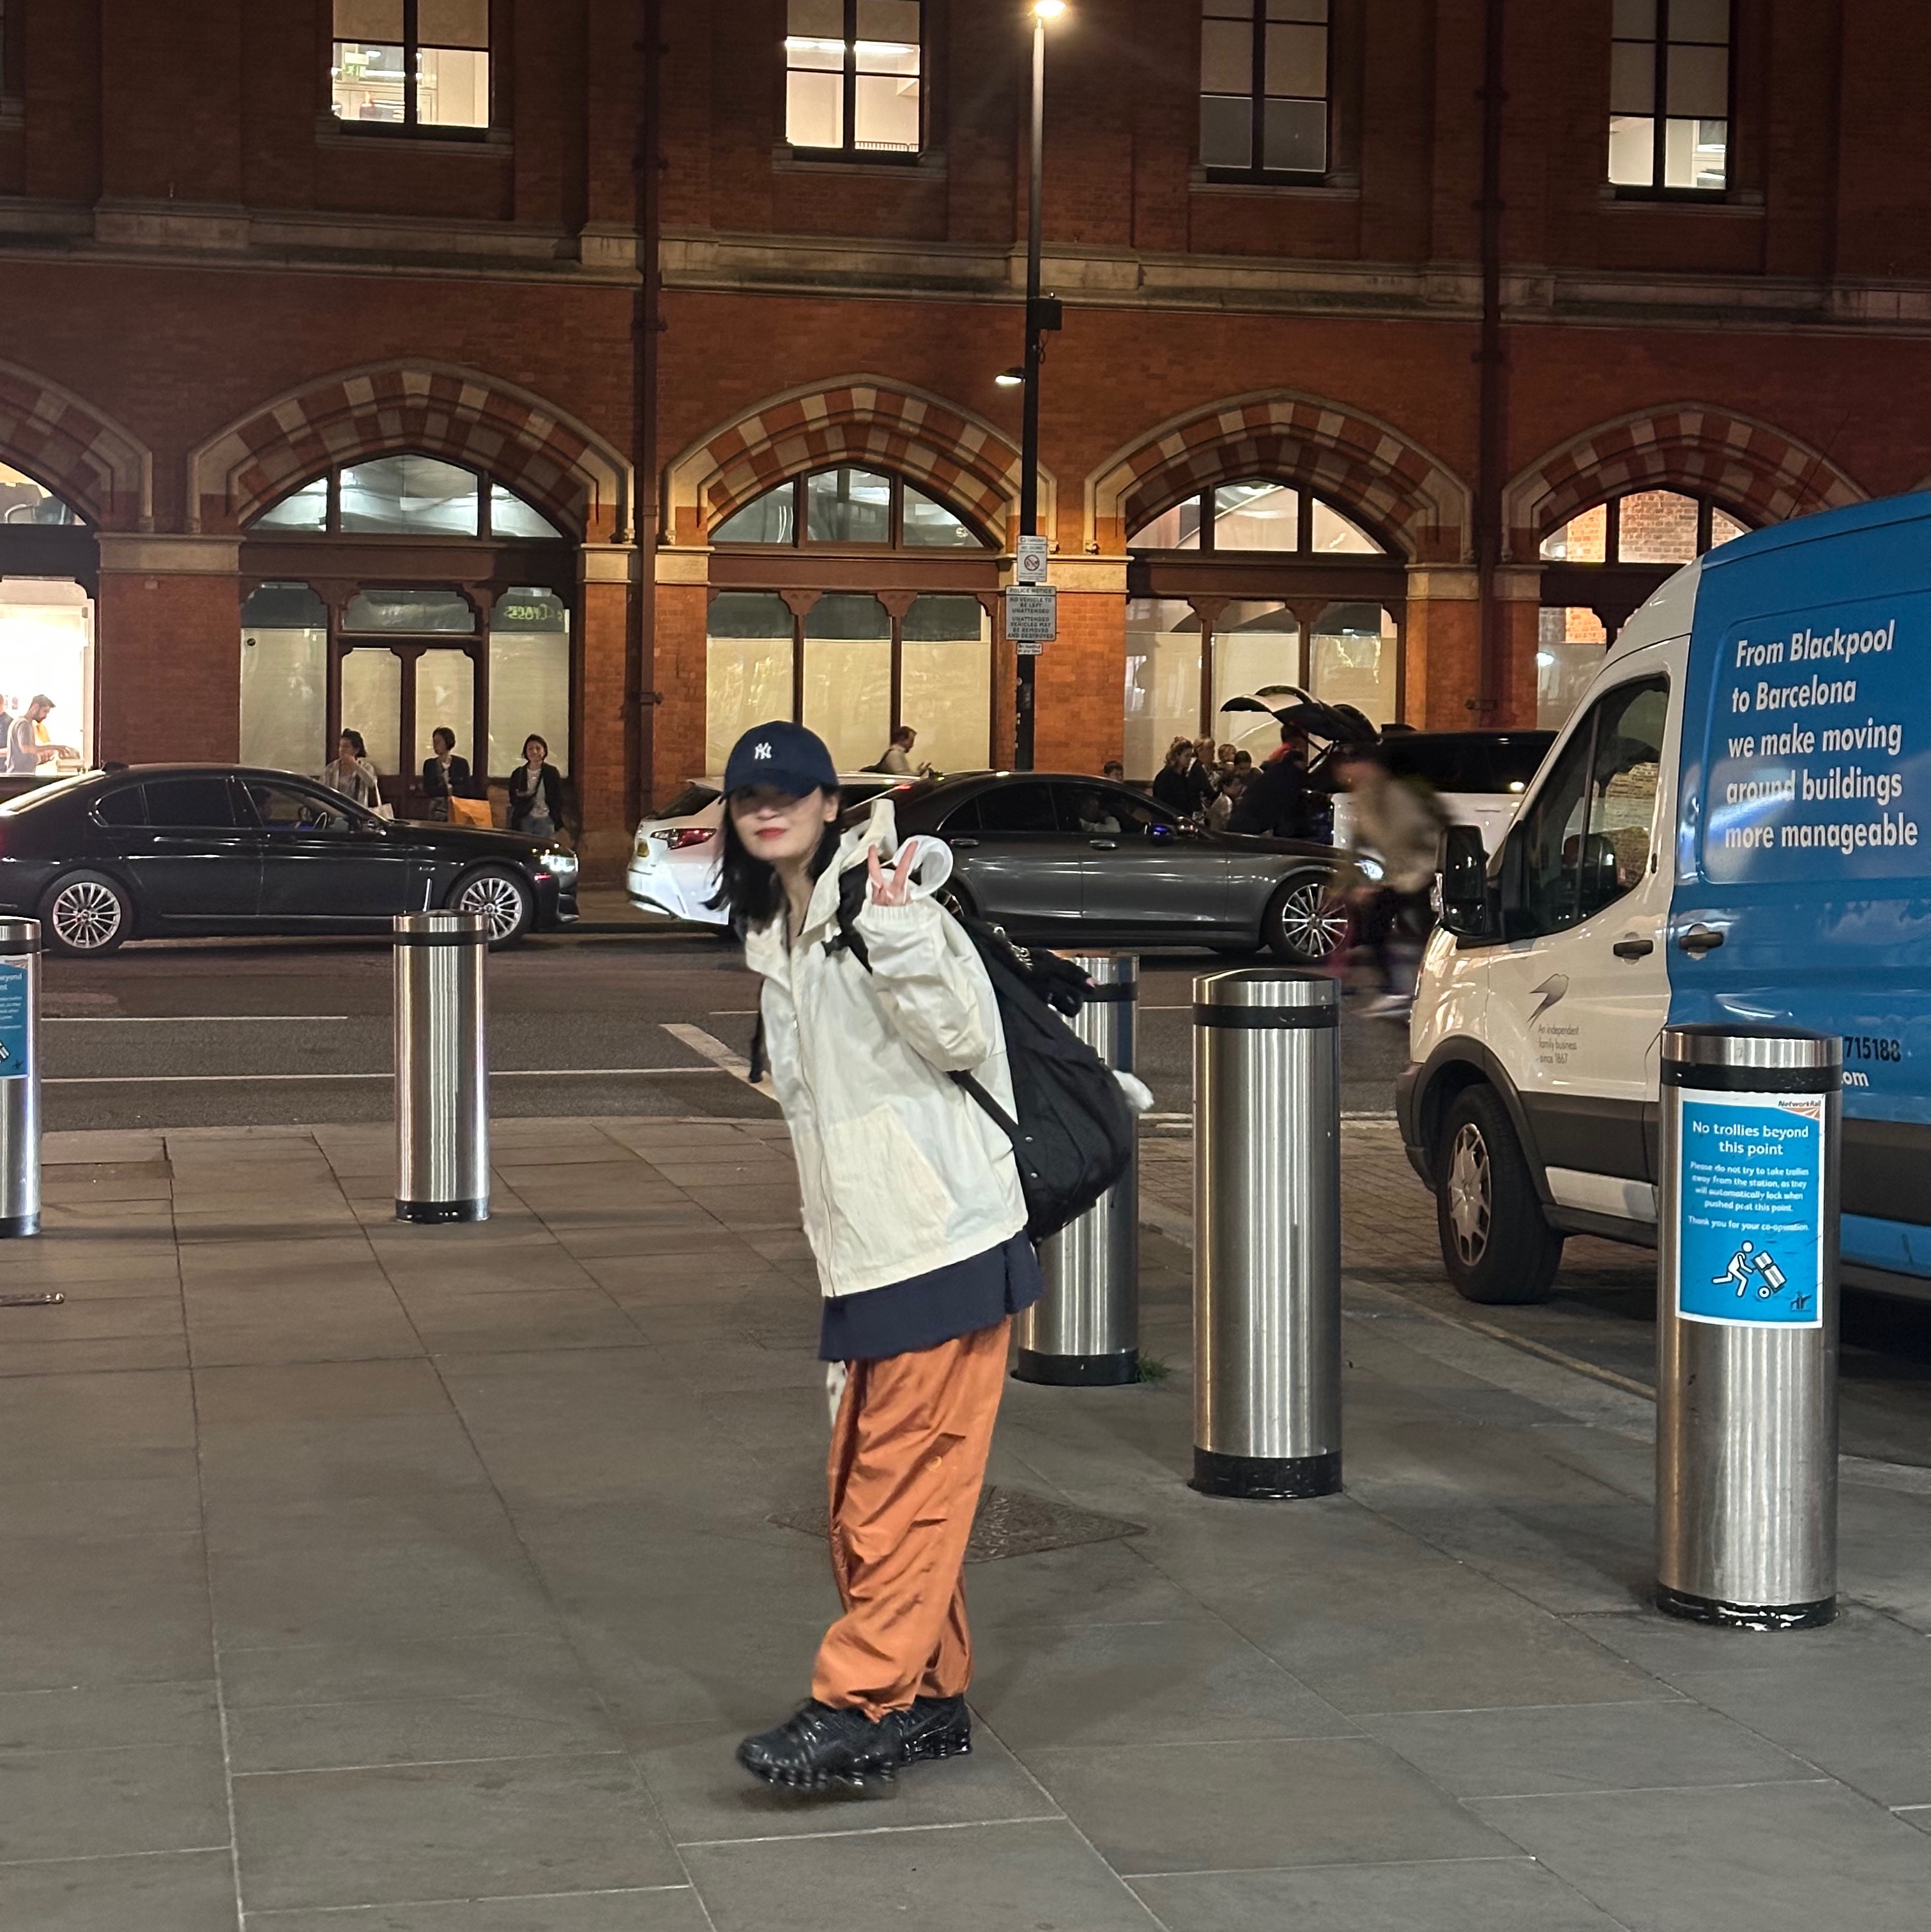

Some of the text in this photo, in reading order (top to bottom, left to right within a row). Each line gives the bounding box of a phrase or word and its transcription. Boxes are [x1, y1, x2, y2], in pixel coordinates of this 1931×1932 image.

[1736, 620, 1896, 667] From Blackpool
[1732, 674, 1856, 713] to Barcelona
[1729, 717, 1902, 757] we make moving
[754, 742, 772, 759] NY
[1727, 766, 1902, 806] around buildings
[1725, 812, 1918, 854] more manageable
[1538, 1023, 1579, 1037] An independent
[1539, 1036, 1577, 1052] family business
[1843, 1036, 1901, 1062] 715188
[1539, 1053, 1569, 1064] since 1867
[1693, 1121, 1809, 1141] No trollies beyond
[1719, 1141, 1783, 1157] this point
[1690, 1161, 1713, 1171] Please
[1743, 1166, 1754, 1176] try
[1767, 1167, 1784, 1175] take
[1692, 1175, 1711, 1184] away
[1713, 1175, 1732, 1184] from
[1749, 1179, 1780, 1188] station,
[1791, 1180, 1807, 1189] they
[1695, 1186, 1803, 1201] will automatically lock when
[1771, 1205, 1793, 1213] point.
[1688, 1215, 1709, 1225] Thank
[1729, 1220, 1740, 1229] for
[1741, 1223, 1760, 1231] your
